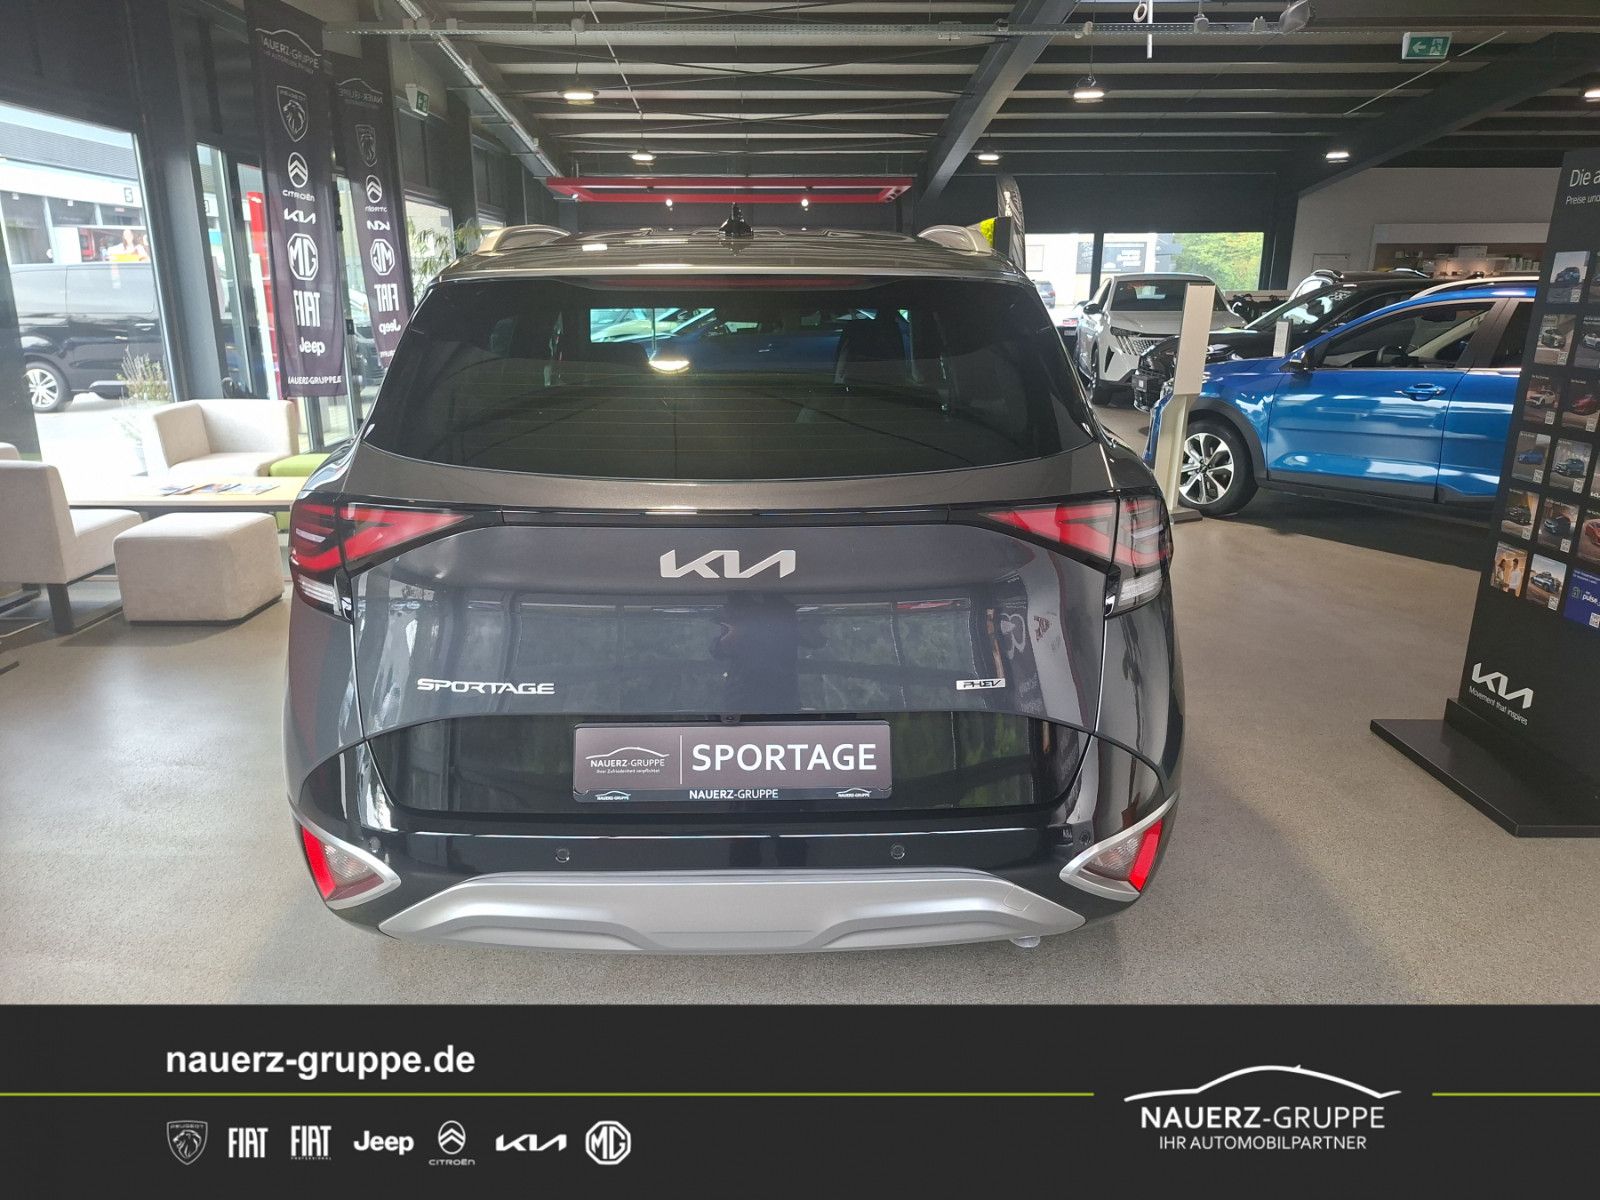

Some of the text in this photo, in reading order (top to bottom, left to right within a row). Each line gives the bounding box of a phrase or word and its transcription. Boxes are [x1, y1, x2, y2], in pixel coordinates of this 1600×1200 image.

[1569, 168, 1591, 187] Die
[1565, 195, 1587, 205] Preise
[283, 208, 316, 225] KIA
[288, 235, 318, 279] MG
[293, 290, 321, 327] FIAT
[299, 336, 326, 356] Jeep
[660, 549, 796, 579] KIA
[417, 677, 556, 695] SPORTAGE
[962, 679, 1002, 689] PHEV
[1471, 662, 1534, 709] KIA
[1469, 685, 1496, 706] Movement
[1496, 701, 1507, 713] that
[590, 758, 665, 768] NAUERZ-GRUPPE
[692, 743, 877, 772] SPORTAGE
[689, 788, 779, 800] NAUERZ-GRUPPE
